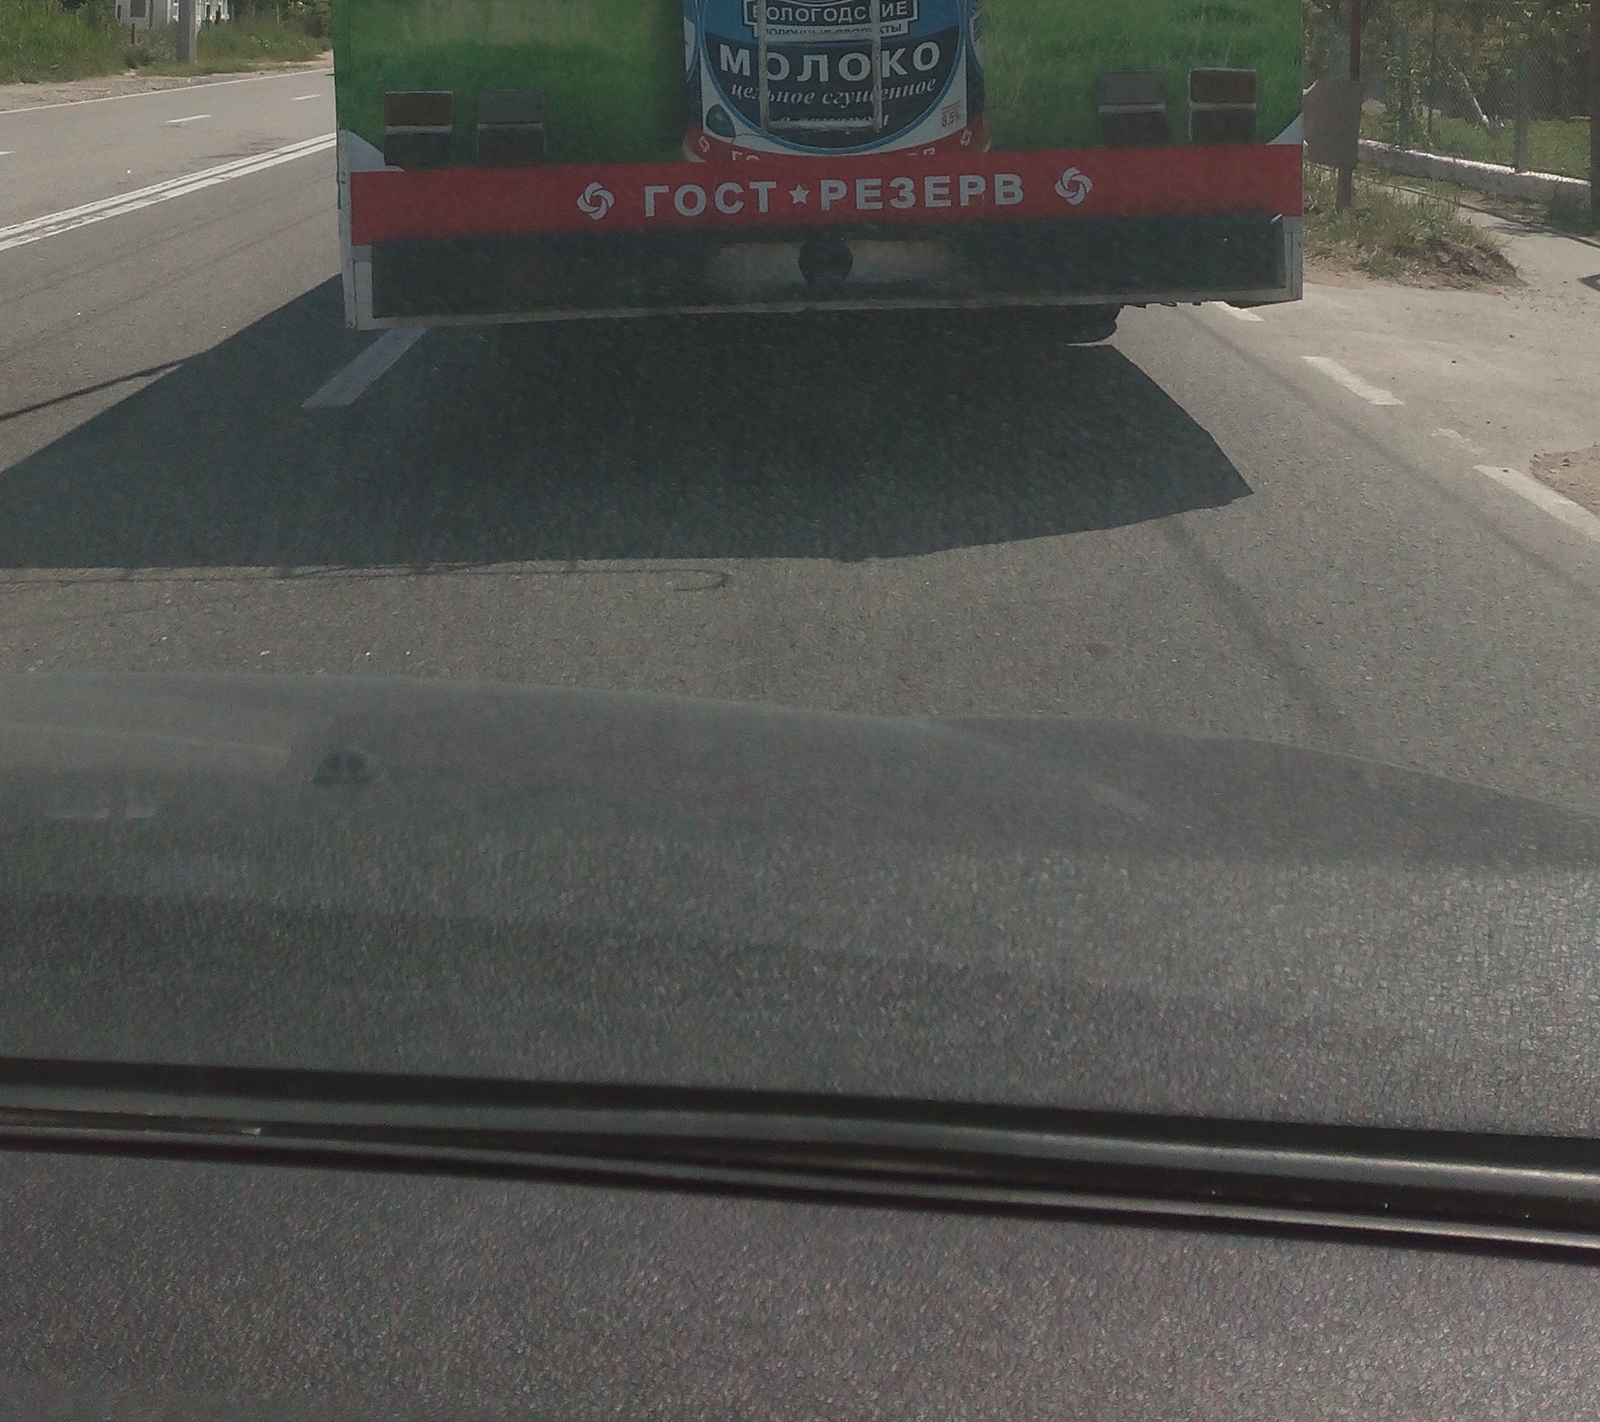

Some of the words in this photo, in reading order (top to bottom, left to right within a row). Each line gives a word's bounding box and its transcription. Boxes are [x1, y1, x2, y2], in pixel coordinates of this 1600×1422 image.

[718, 40, 941, 83] МОЛОКО
[644, 181, 778, 217] ГОСТ
[819, 173, 1025, 212] РЕЗЕРВ
